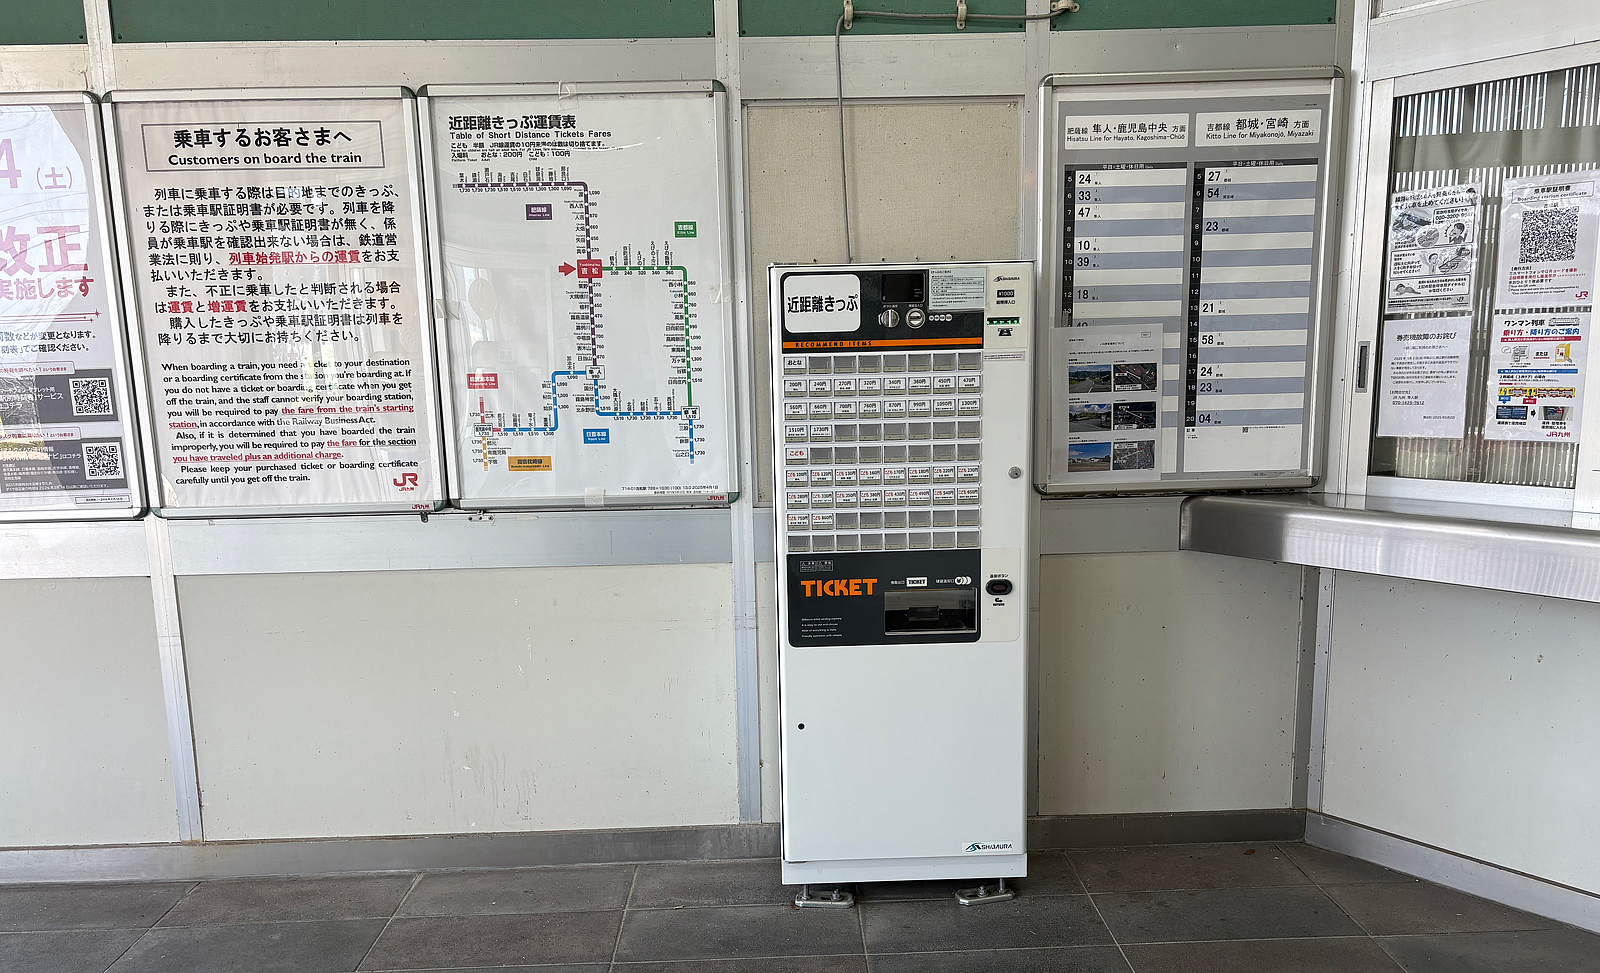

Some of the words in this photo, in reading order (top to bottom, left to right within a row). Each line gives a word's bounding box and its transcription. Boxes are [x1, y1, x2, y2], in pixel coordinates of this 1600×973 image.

[448, 114, 576, 130] 近距離きっぷ運賃表
[1092, 122, 1168, 134] 隼人・鹿児島中央
[1172, 125, 1186, 133] 方面
[1207, 123, 1231, 132] 吉都線
[1235, 117, 1289, 131] 都城・宮崎
[1293, 120, 1310, 129] 方面
[173, 128, 352, 149] 乗車するお客さまへ
[450, 132, 473, 140] Table
[476, 131, 485, 140] of
[488, 131, 511, 139] Short
[515, 131, 550, 139] Distance
[554, 130, 585, 138] Tickets
[588, 130, 612, 138] Fares
[1223, 132, 1236, 140] Line
[1287, 130, 1314, 138] Miyazaki
[168, 155, 239, 165] Customers
[264, 153, 301, 163] board
[305, 153, 327, 163] the
[331, 152, 361, 162] train
[1078, 174, 1091, 184] 24
[1208, 171, 1221, 182] 27
[154, 185, 399, 201] 列車に乗車する際は目的地までのきっぷ、
[1078, 191, 1091, 201] 33
[1207, 188, 1220, 198] 54
[143, 201, 395, 218] または乗車駅証明書が必要です。列車を降
[1078, 207, 1091, 218] 47
[146, 217, 397, 234] りる際にきっぷや乗車駅証明書が無く、係
[1206, 221, 1219, 232] 23
[148, 232, 398, 251] 員が乗車駅を確認出来ない場合は、鉄道営
[1078, 241, 1090, 251] 10
[0, 225, 88, 277] 改正
[148, 249, 400, 266] 業法に則り、列車始発駅からの運賃をお支
[1077, 257, 1090, 267] 39
[150, 267, 264, 283] 払いいただきます。
[166, 280, 402, 298] また、不正に乗車したと判断される場合
[1077, 290, 1089, 300] 18
[155, 296, 398, 315] は運賃と増運賃をお支払いいただきます。
[787, 293, 859, 314] 近距離きっぷ
[1202, 303, 1214, 313] 21
[170, 312, 403, 330] 購入したきっぷや乗車駅証明書は列車を
[1504, 319, 1546, 327] ワンマン列車
[158, 328, 360, 346] 降りるまで大切にお持ちください。
[1201, 335, 1214, 345] 58
[1200, 367, 1212, 377] 24
[1200, 383, 1212, 392] 23
[195, 397, 217, 406] train,
[301, 395, 324, 404] verify
[326, 395, 344, 404] your
[346, 393, 382, 404] boarding
[384, 391, 413, 401] station,
[167, 411, 182, 419] you
[215, 408, 250, 417] required
[282, 407, 295, 415] the
[298, 407, 314, 415] fare
[317, 406, 336, 414] from
[339, 405, 352, 414] the
[356, 404, 380, 413] train's
[383, 404, 414, 413] starting
[169, 420, 199, 429] station,
[277, 418, 290, 426] the
[292, 417, 322, 426] Railway
[359, 416, 375, 424] Act.
[1198, 414, 1211, 424] 04
[176, 432, 196, 440] Also,
[229, 430, 275, 438] determined
[301, 430, 315, 439] you
[341, 427, 374, 435] boarded
[393, 473, 419, 487] JR
[800, 578, 878, 597] TICKET
